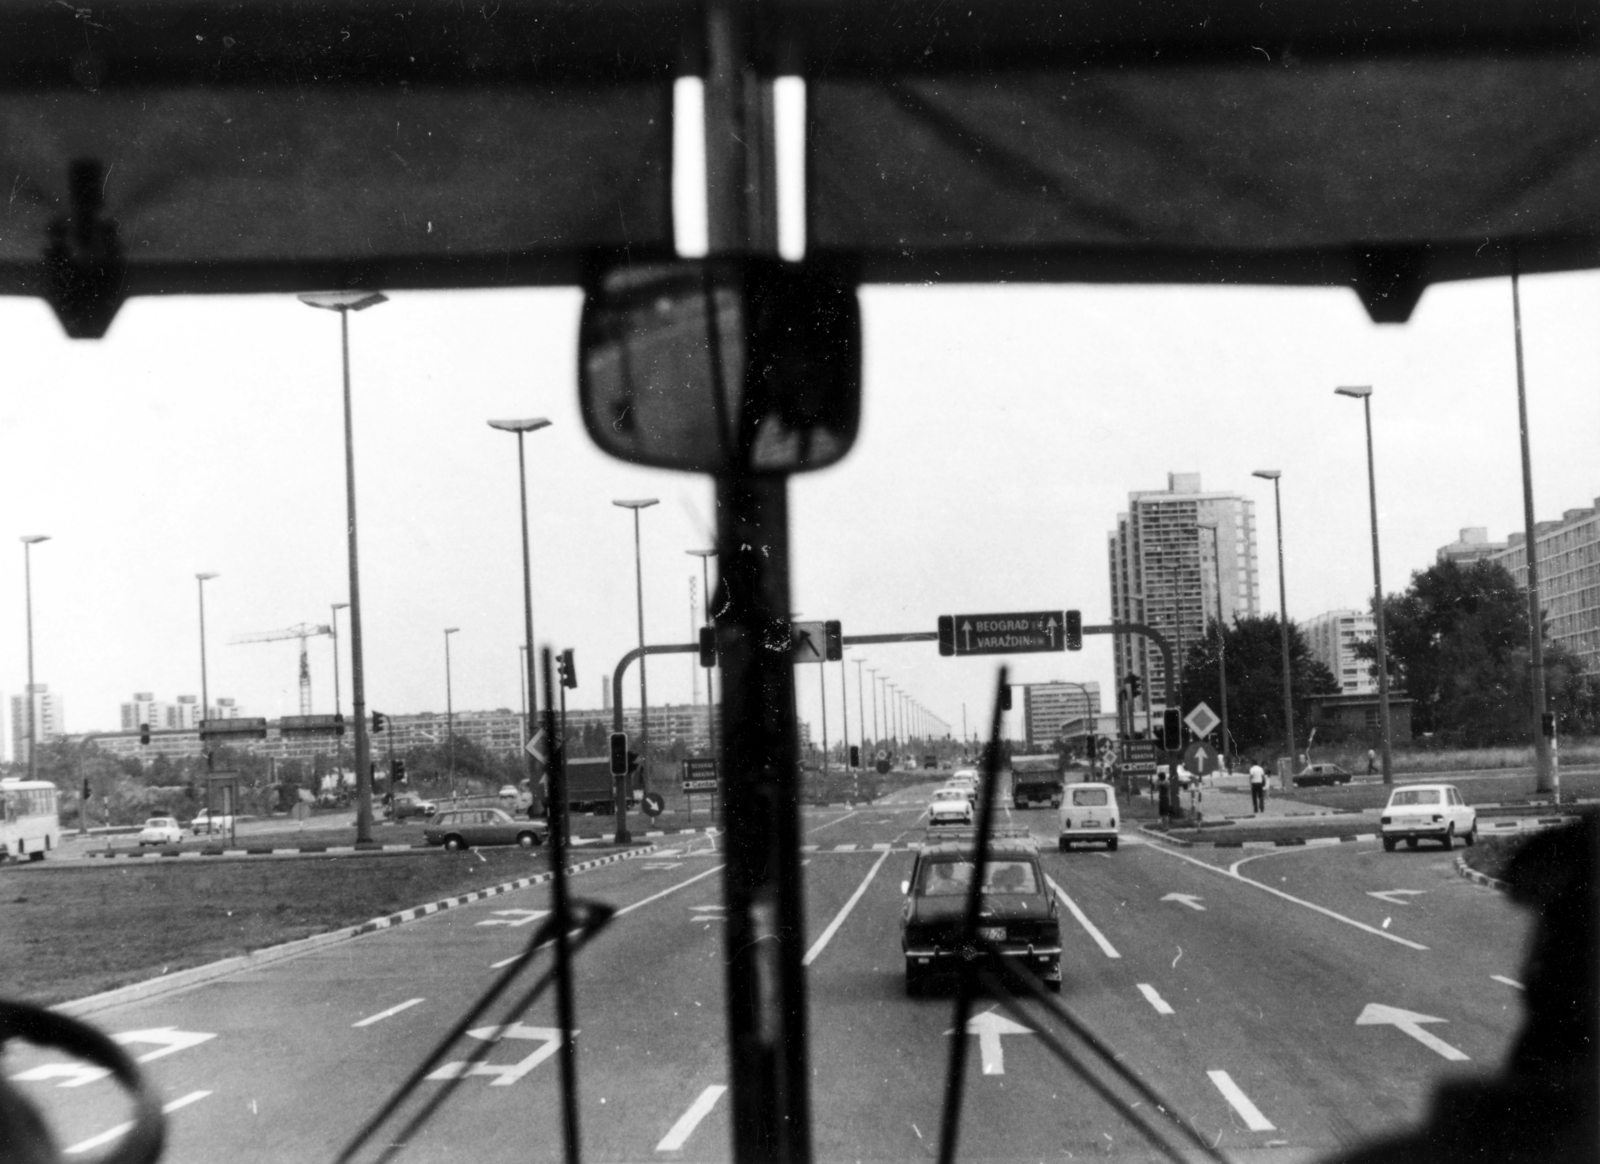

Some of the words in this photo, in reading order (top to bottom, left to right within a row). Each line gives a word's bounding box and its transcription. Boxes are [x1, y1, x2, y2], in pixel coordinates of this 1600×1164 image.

[976, 619, 1029, 632] BEOGRAD
[977, 634, 1030, 648] VARAŽDIN
[1132, 762, 1155, 770] Centar
